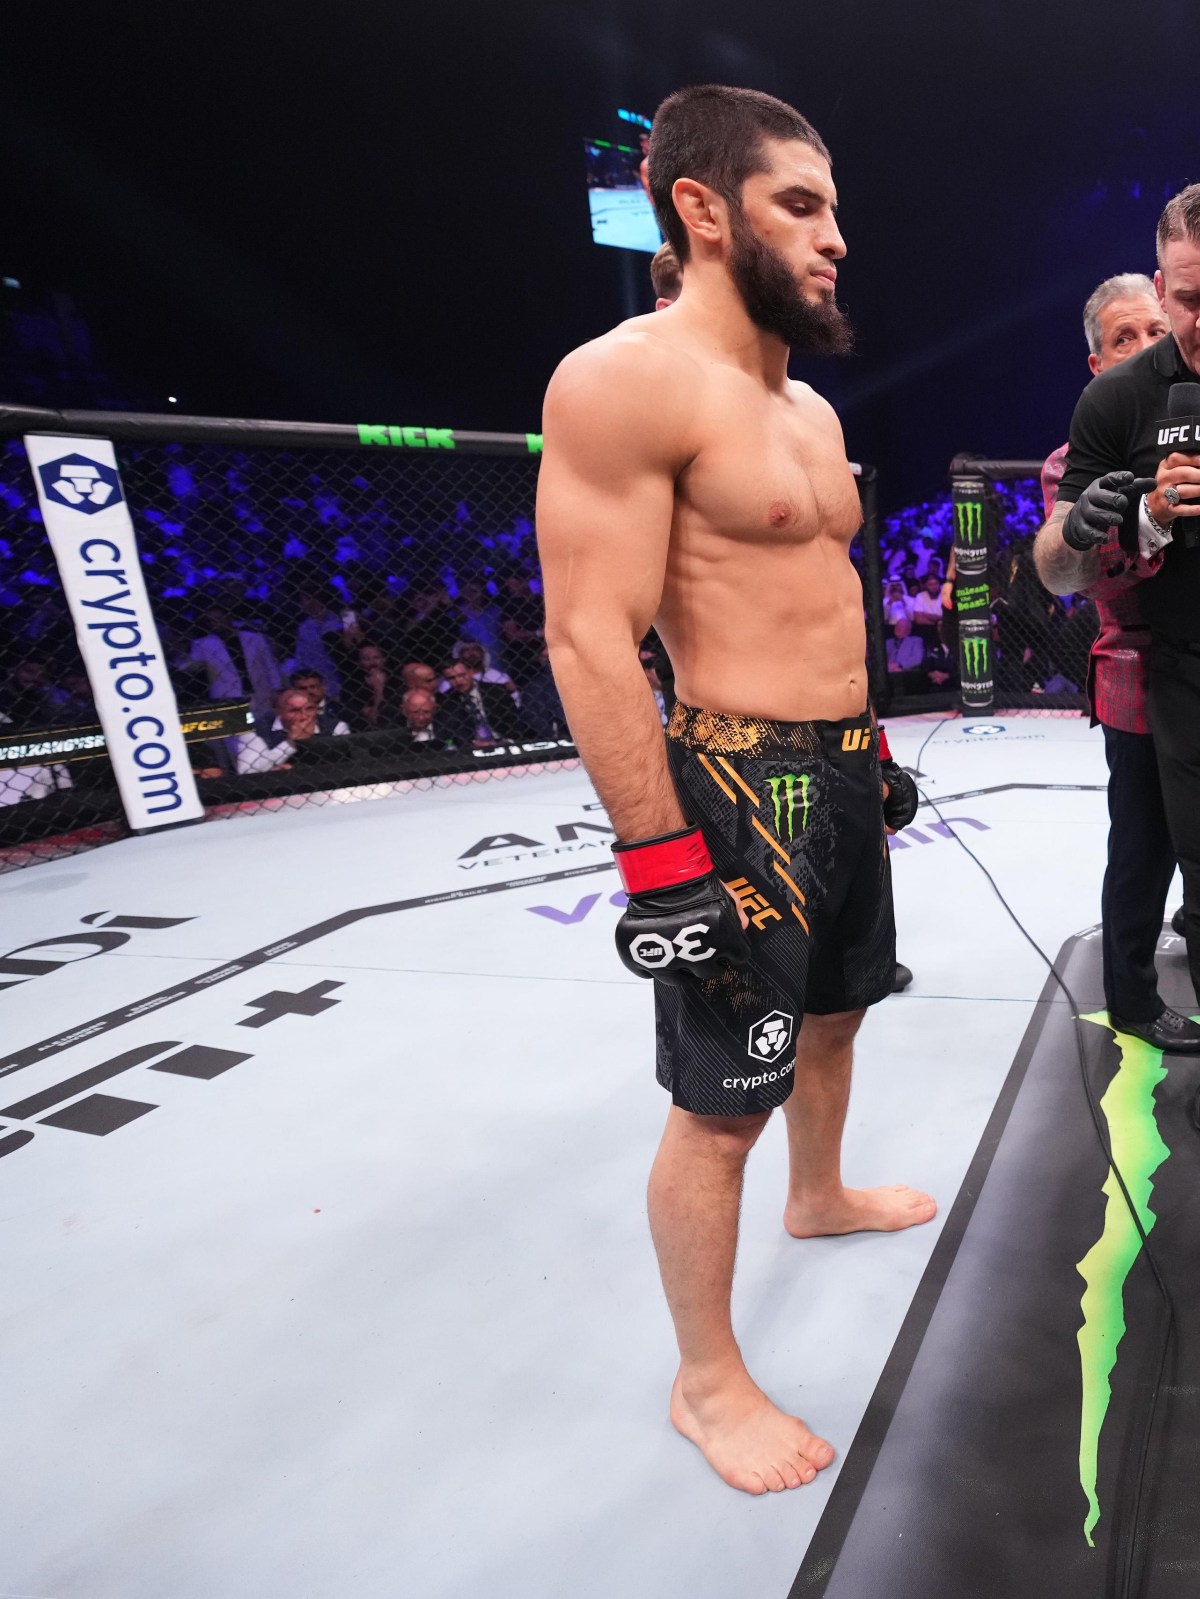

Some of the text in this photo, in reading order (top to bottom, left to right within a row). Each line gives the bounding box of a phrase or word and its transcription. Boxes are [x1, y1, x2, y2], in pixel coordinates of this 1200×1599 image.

[357, 424, 455, 449] KICK
[1157, 424, 1190, 446] UFC
[79, 538, 183, 815] crypto.com
[723, 876, 783, 931] UFC
[640, 946, 663, 958] UFC
